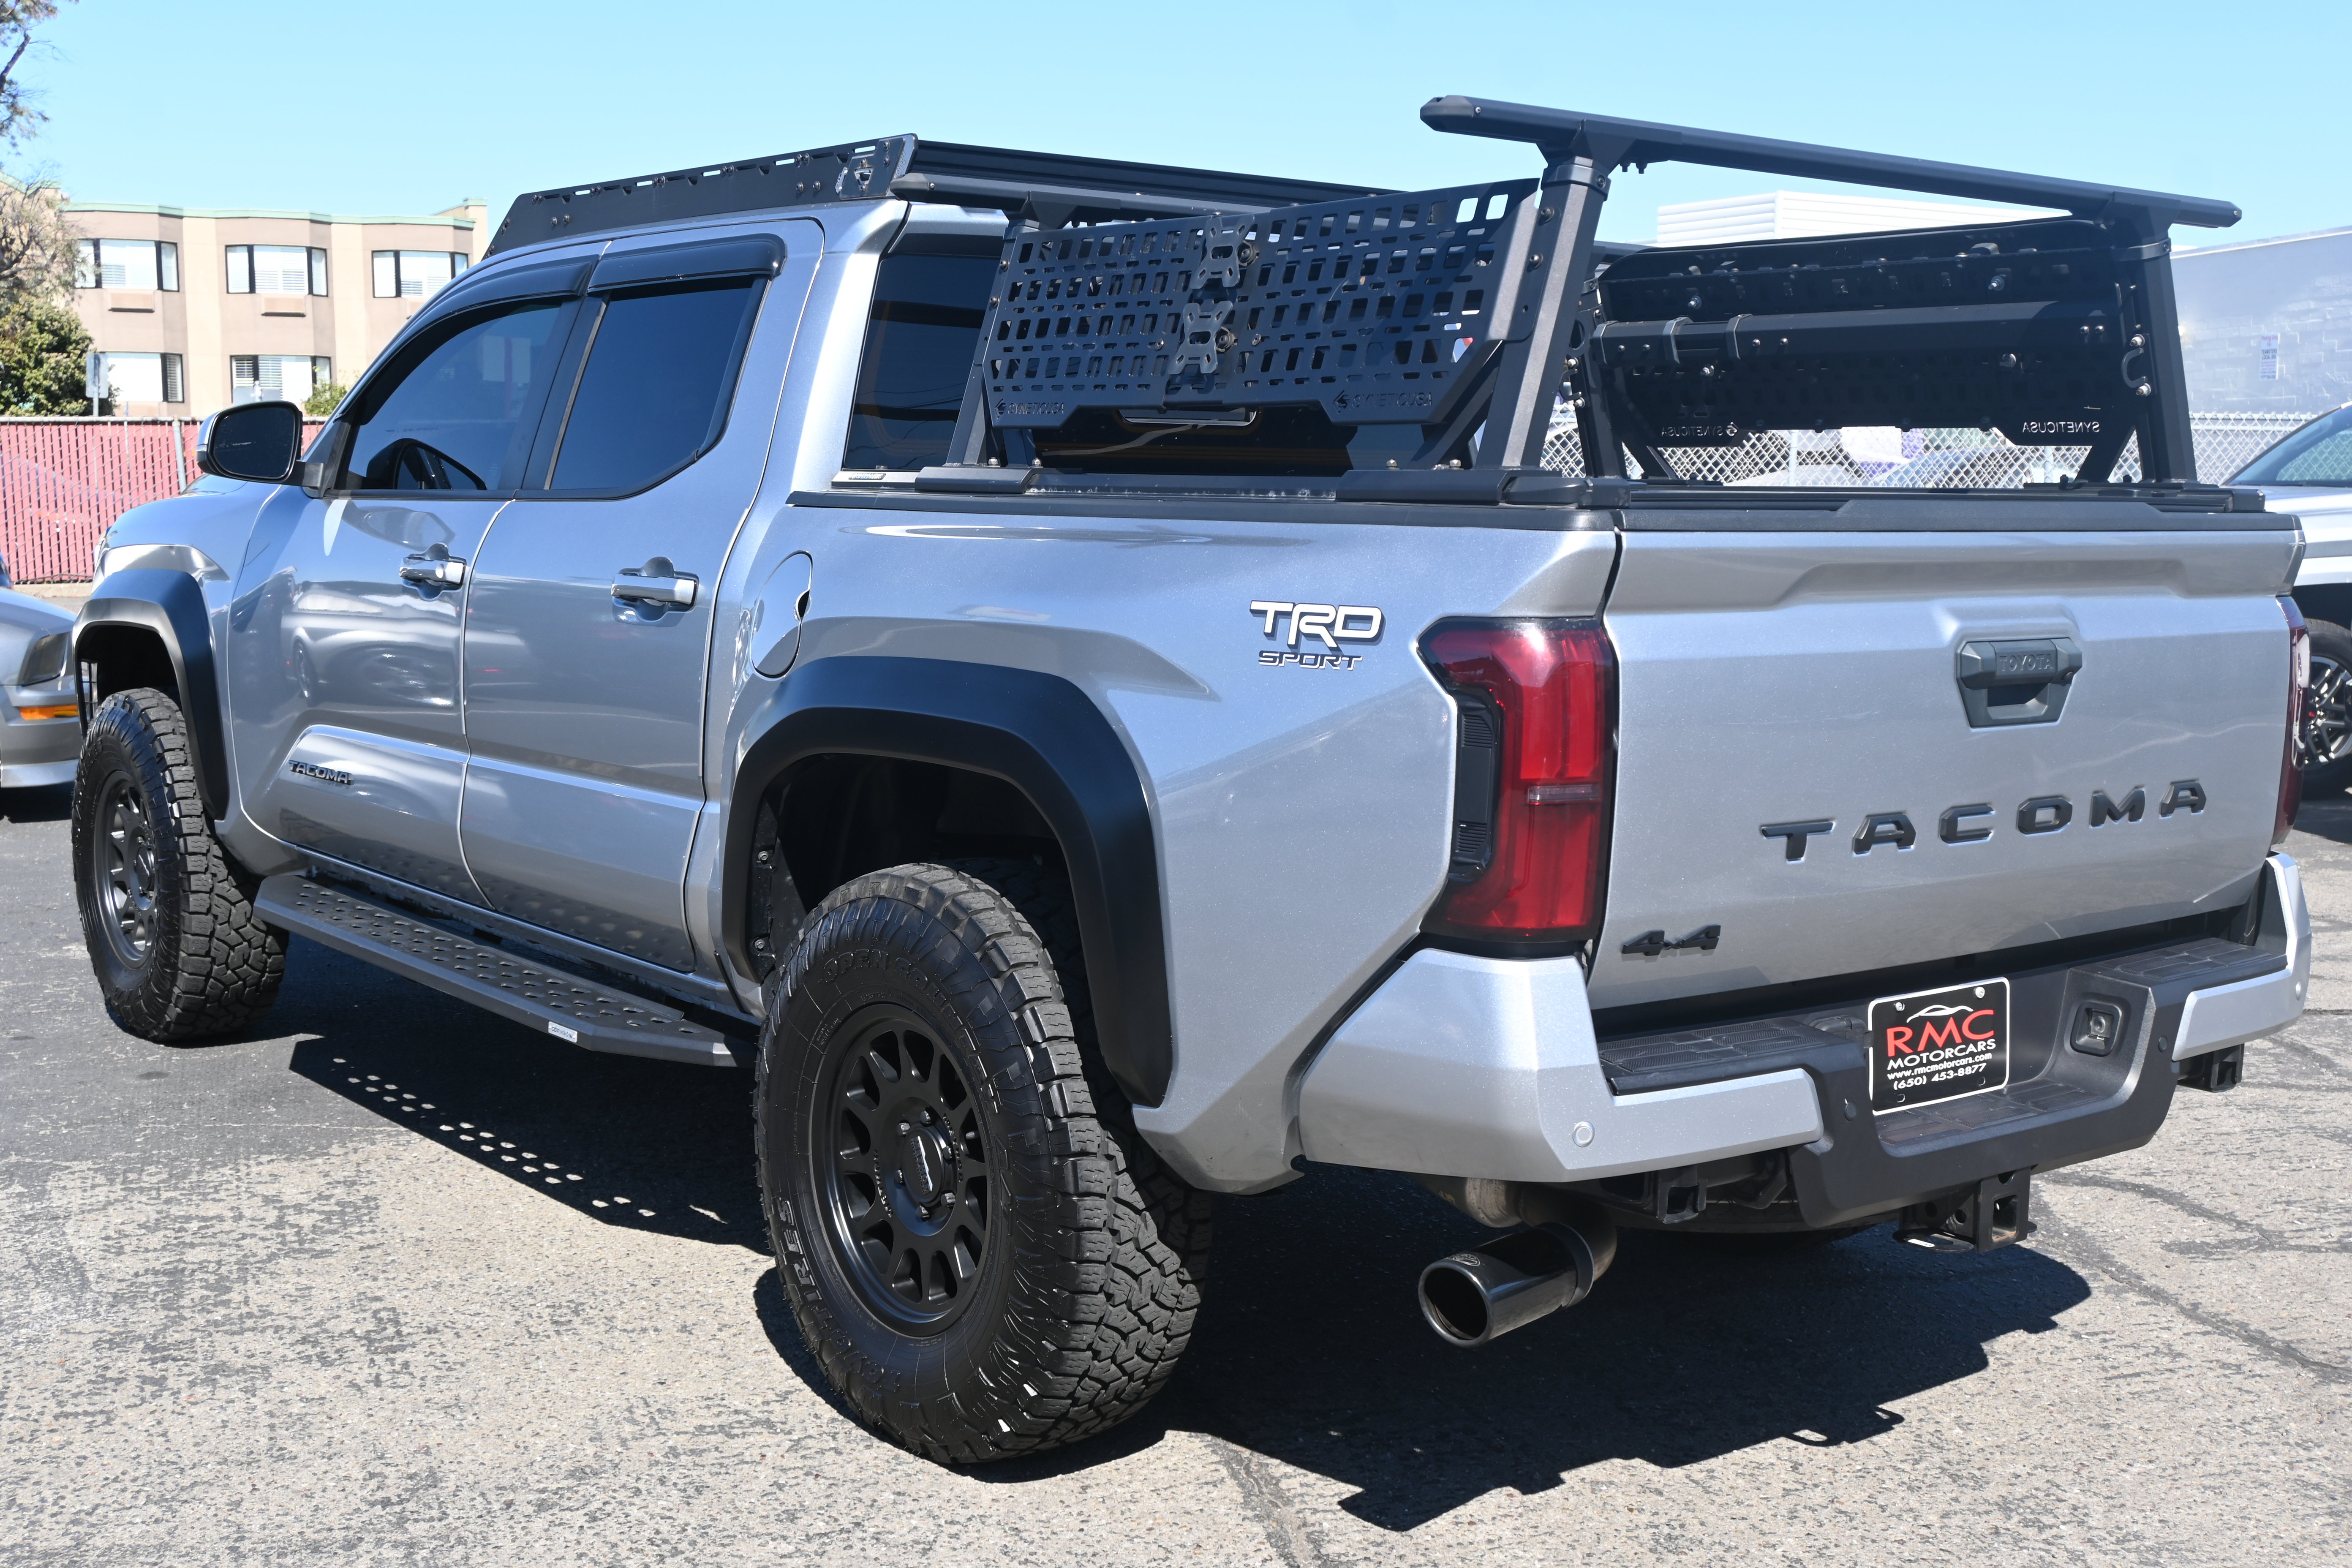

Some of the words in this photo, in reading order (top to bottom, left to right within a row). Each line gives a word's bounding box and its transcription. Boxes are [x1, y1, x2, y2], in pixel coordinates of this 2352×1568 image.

[1007, 402, 1064, 415] SYNETICUSA
[1352, 392, 1432, 408] SYNETICUSA
[1250, 600, 1386, 648] TRD
[1258, 650, 1363, 671] SPORT
[1999, 653, 2054, 672] TOYOTA
[288, 760, 354, 786] TACOMA
[1760, 779, 2207, 863] TACOMA
[824, 949, 889, 983] OPEN
[1886, 1009, 1995, 1057] RMC
[1887, 1039, 1996, 1070] MOTORCARS
[1887, 1052, 1992, 1080] www.rmcmotorcars.com
[1893, 1075, 1927, 1090] (650)
[1931, 1062, 1987, 1082] 453-8877
[777, 1197, 833, 1329] TIRES
